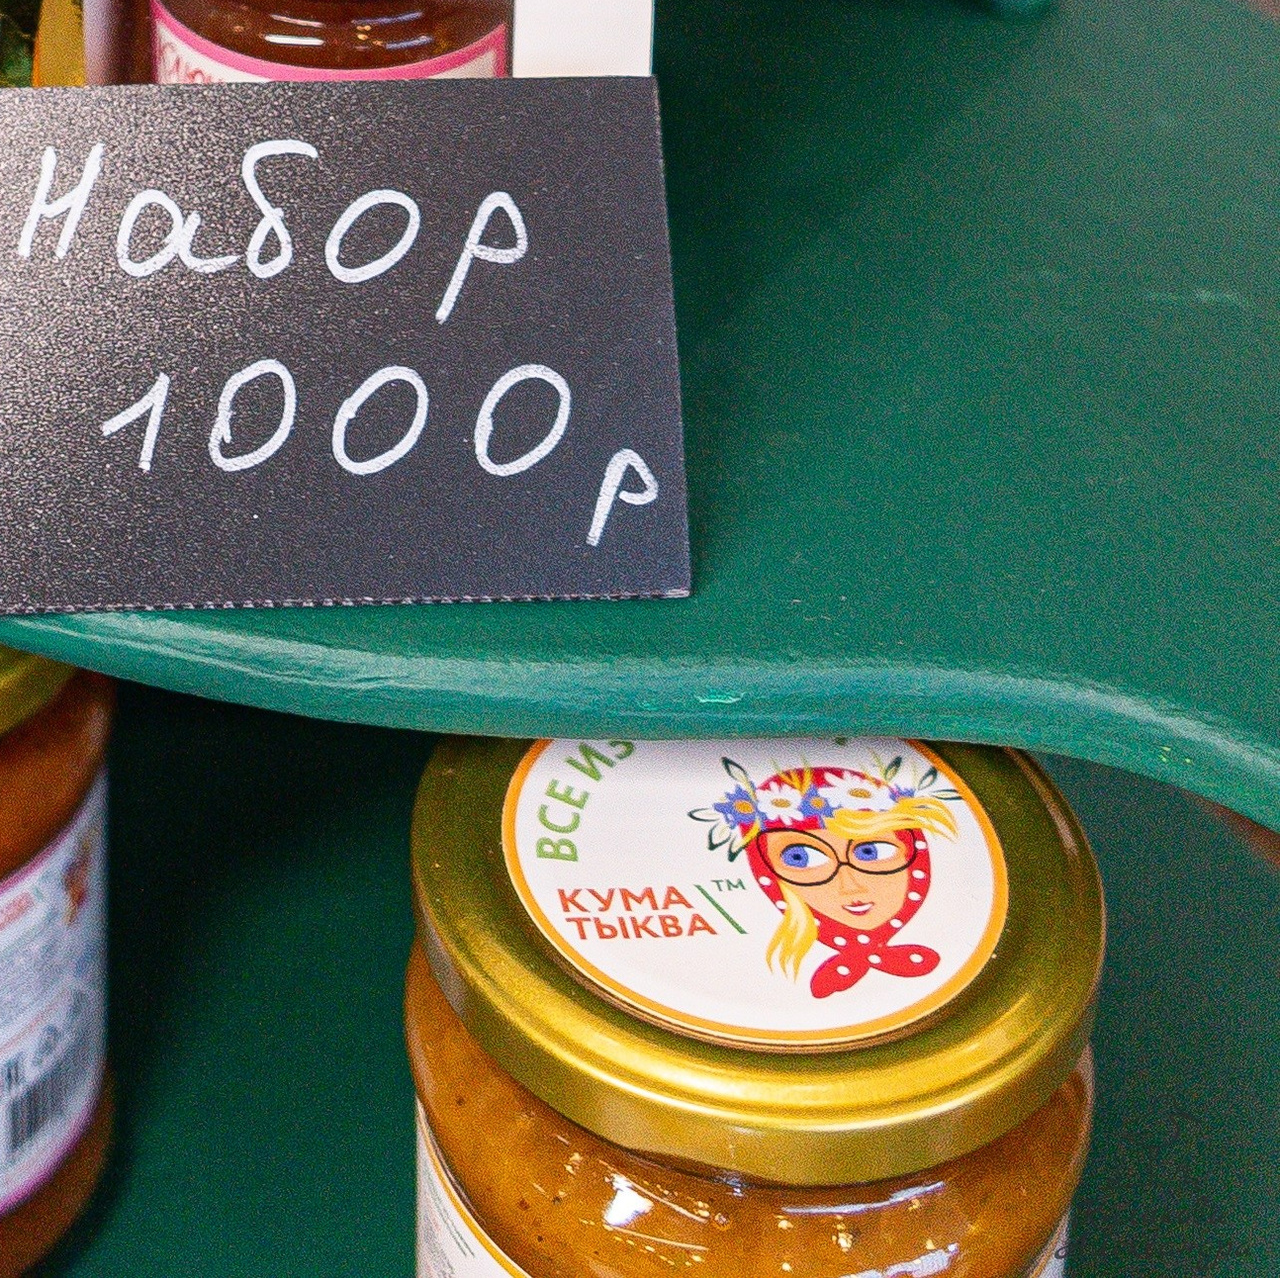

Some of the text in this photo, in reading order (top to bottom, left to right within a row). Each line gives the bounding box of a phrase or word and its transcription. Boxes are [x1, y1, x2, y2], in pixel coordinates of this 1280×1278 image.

[19, 139, 529, 325] Набор
[535, 778, 591, 863] ВСЕ
[557, 885, 695, 914] КУМА
[565, 912, 719, 941] ТЫКВА
